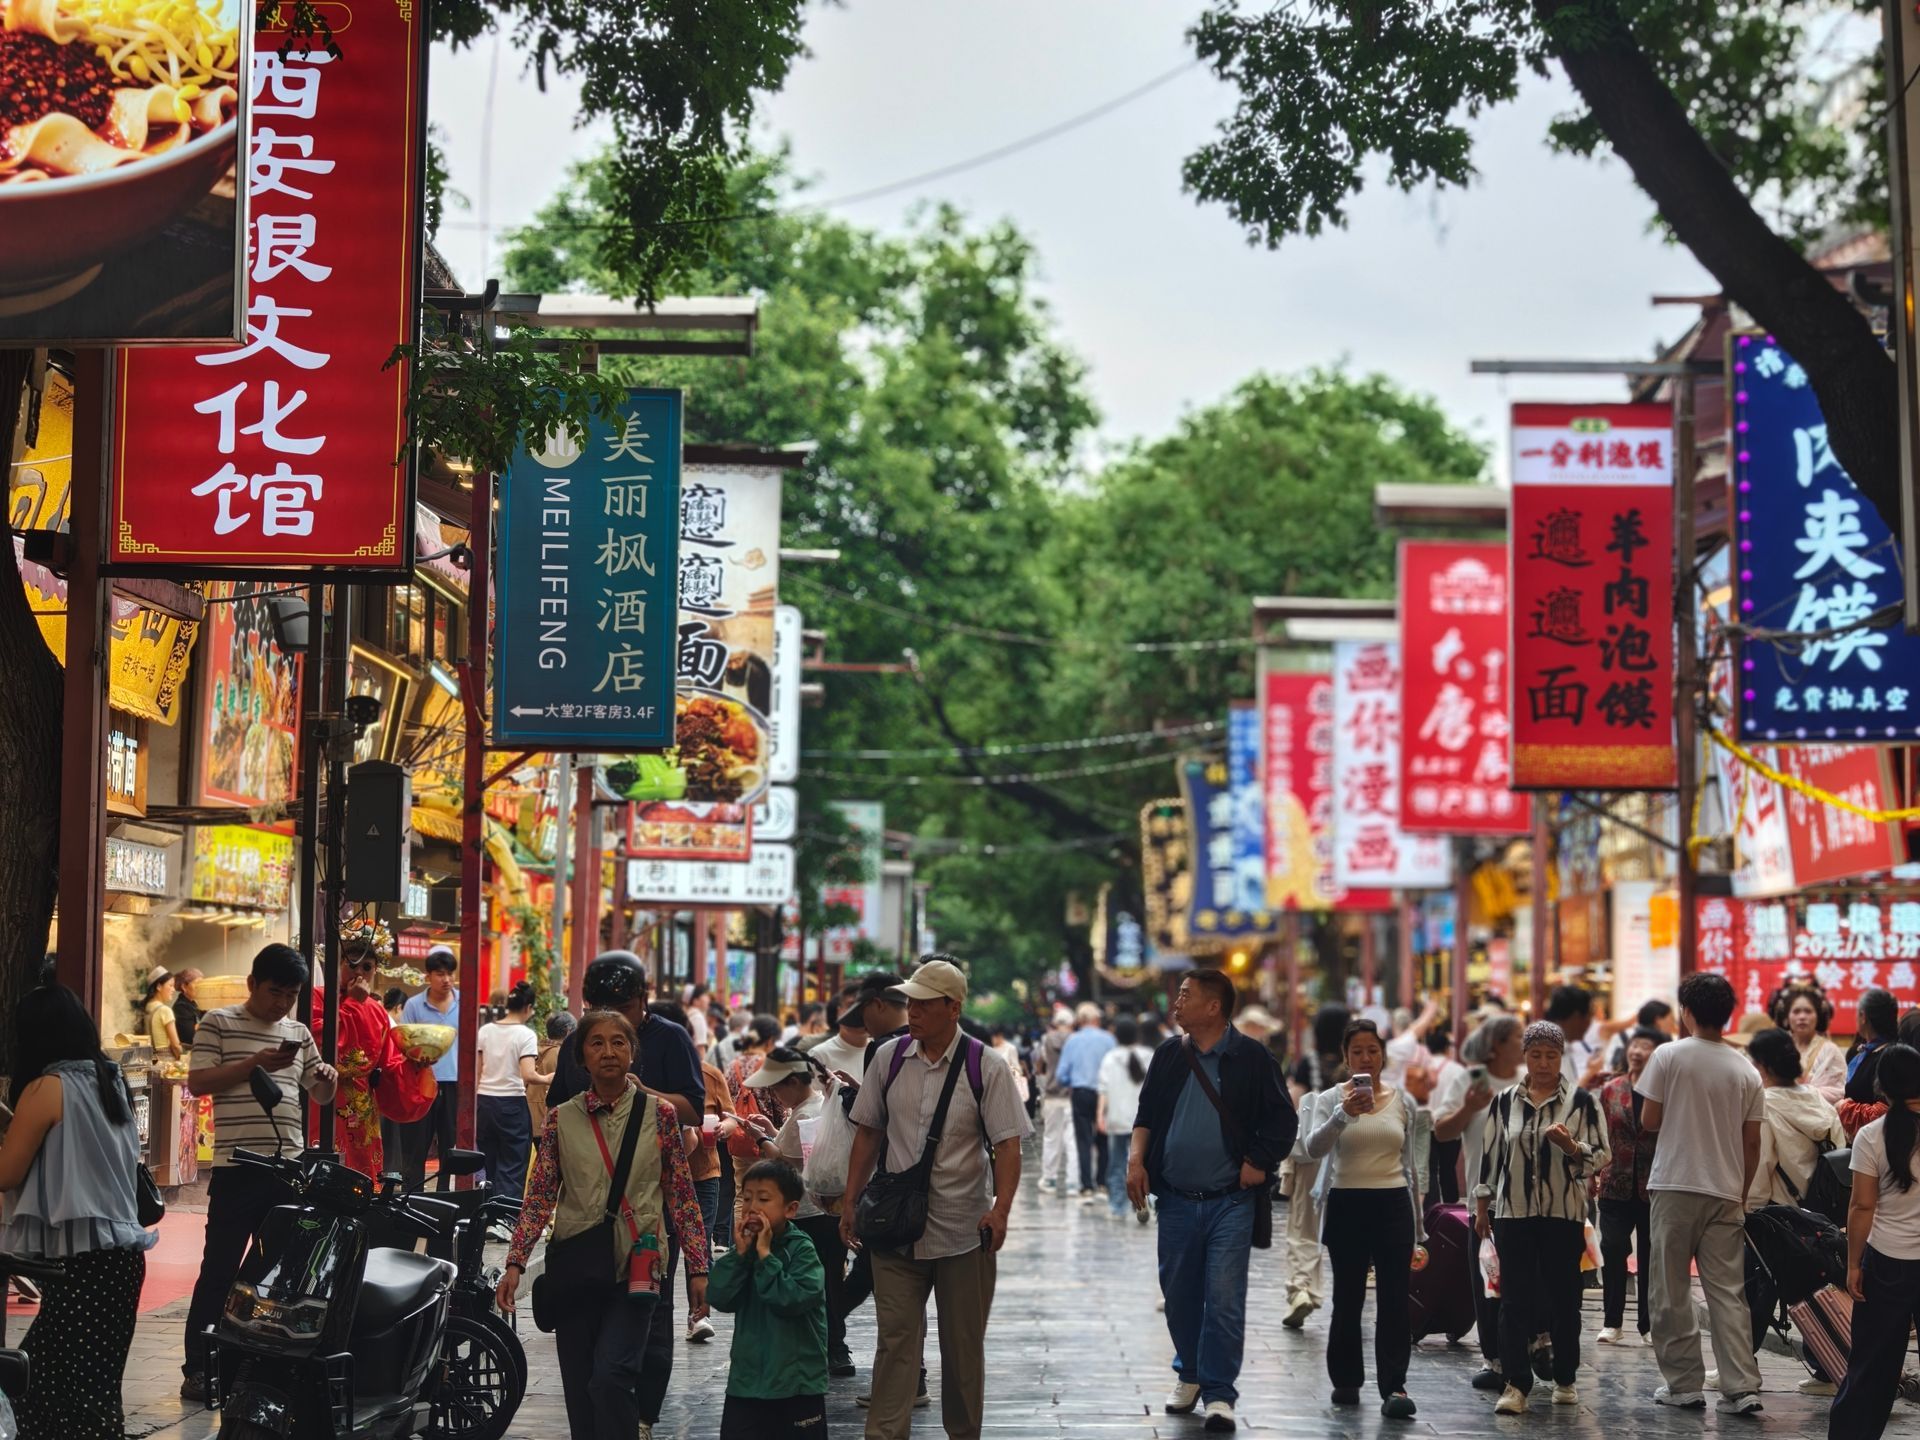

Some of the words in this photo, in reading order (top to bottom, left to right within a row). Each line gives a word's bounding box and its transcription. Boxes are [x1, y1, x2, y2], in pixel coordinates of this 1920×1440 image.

[538, 478, 571, 670] MEILIFENG
[593, 411, 655, 693] 美丽枫酒店
[1596, 509, 1657, 728] 羊肉泡馍
[545, 703, 655, 719] 大堂2F客房3.4F
[1775, 687, 1909, 712] 免费抽真空
